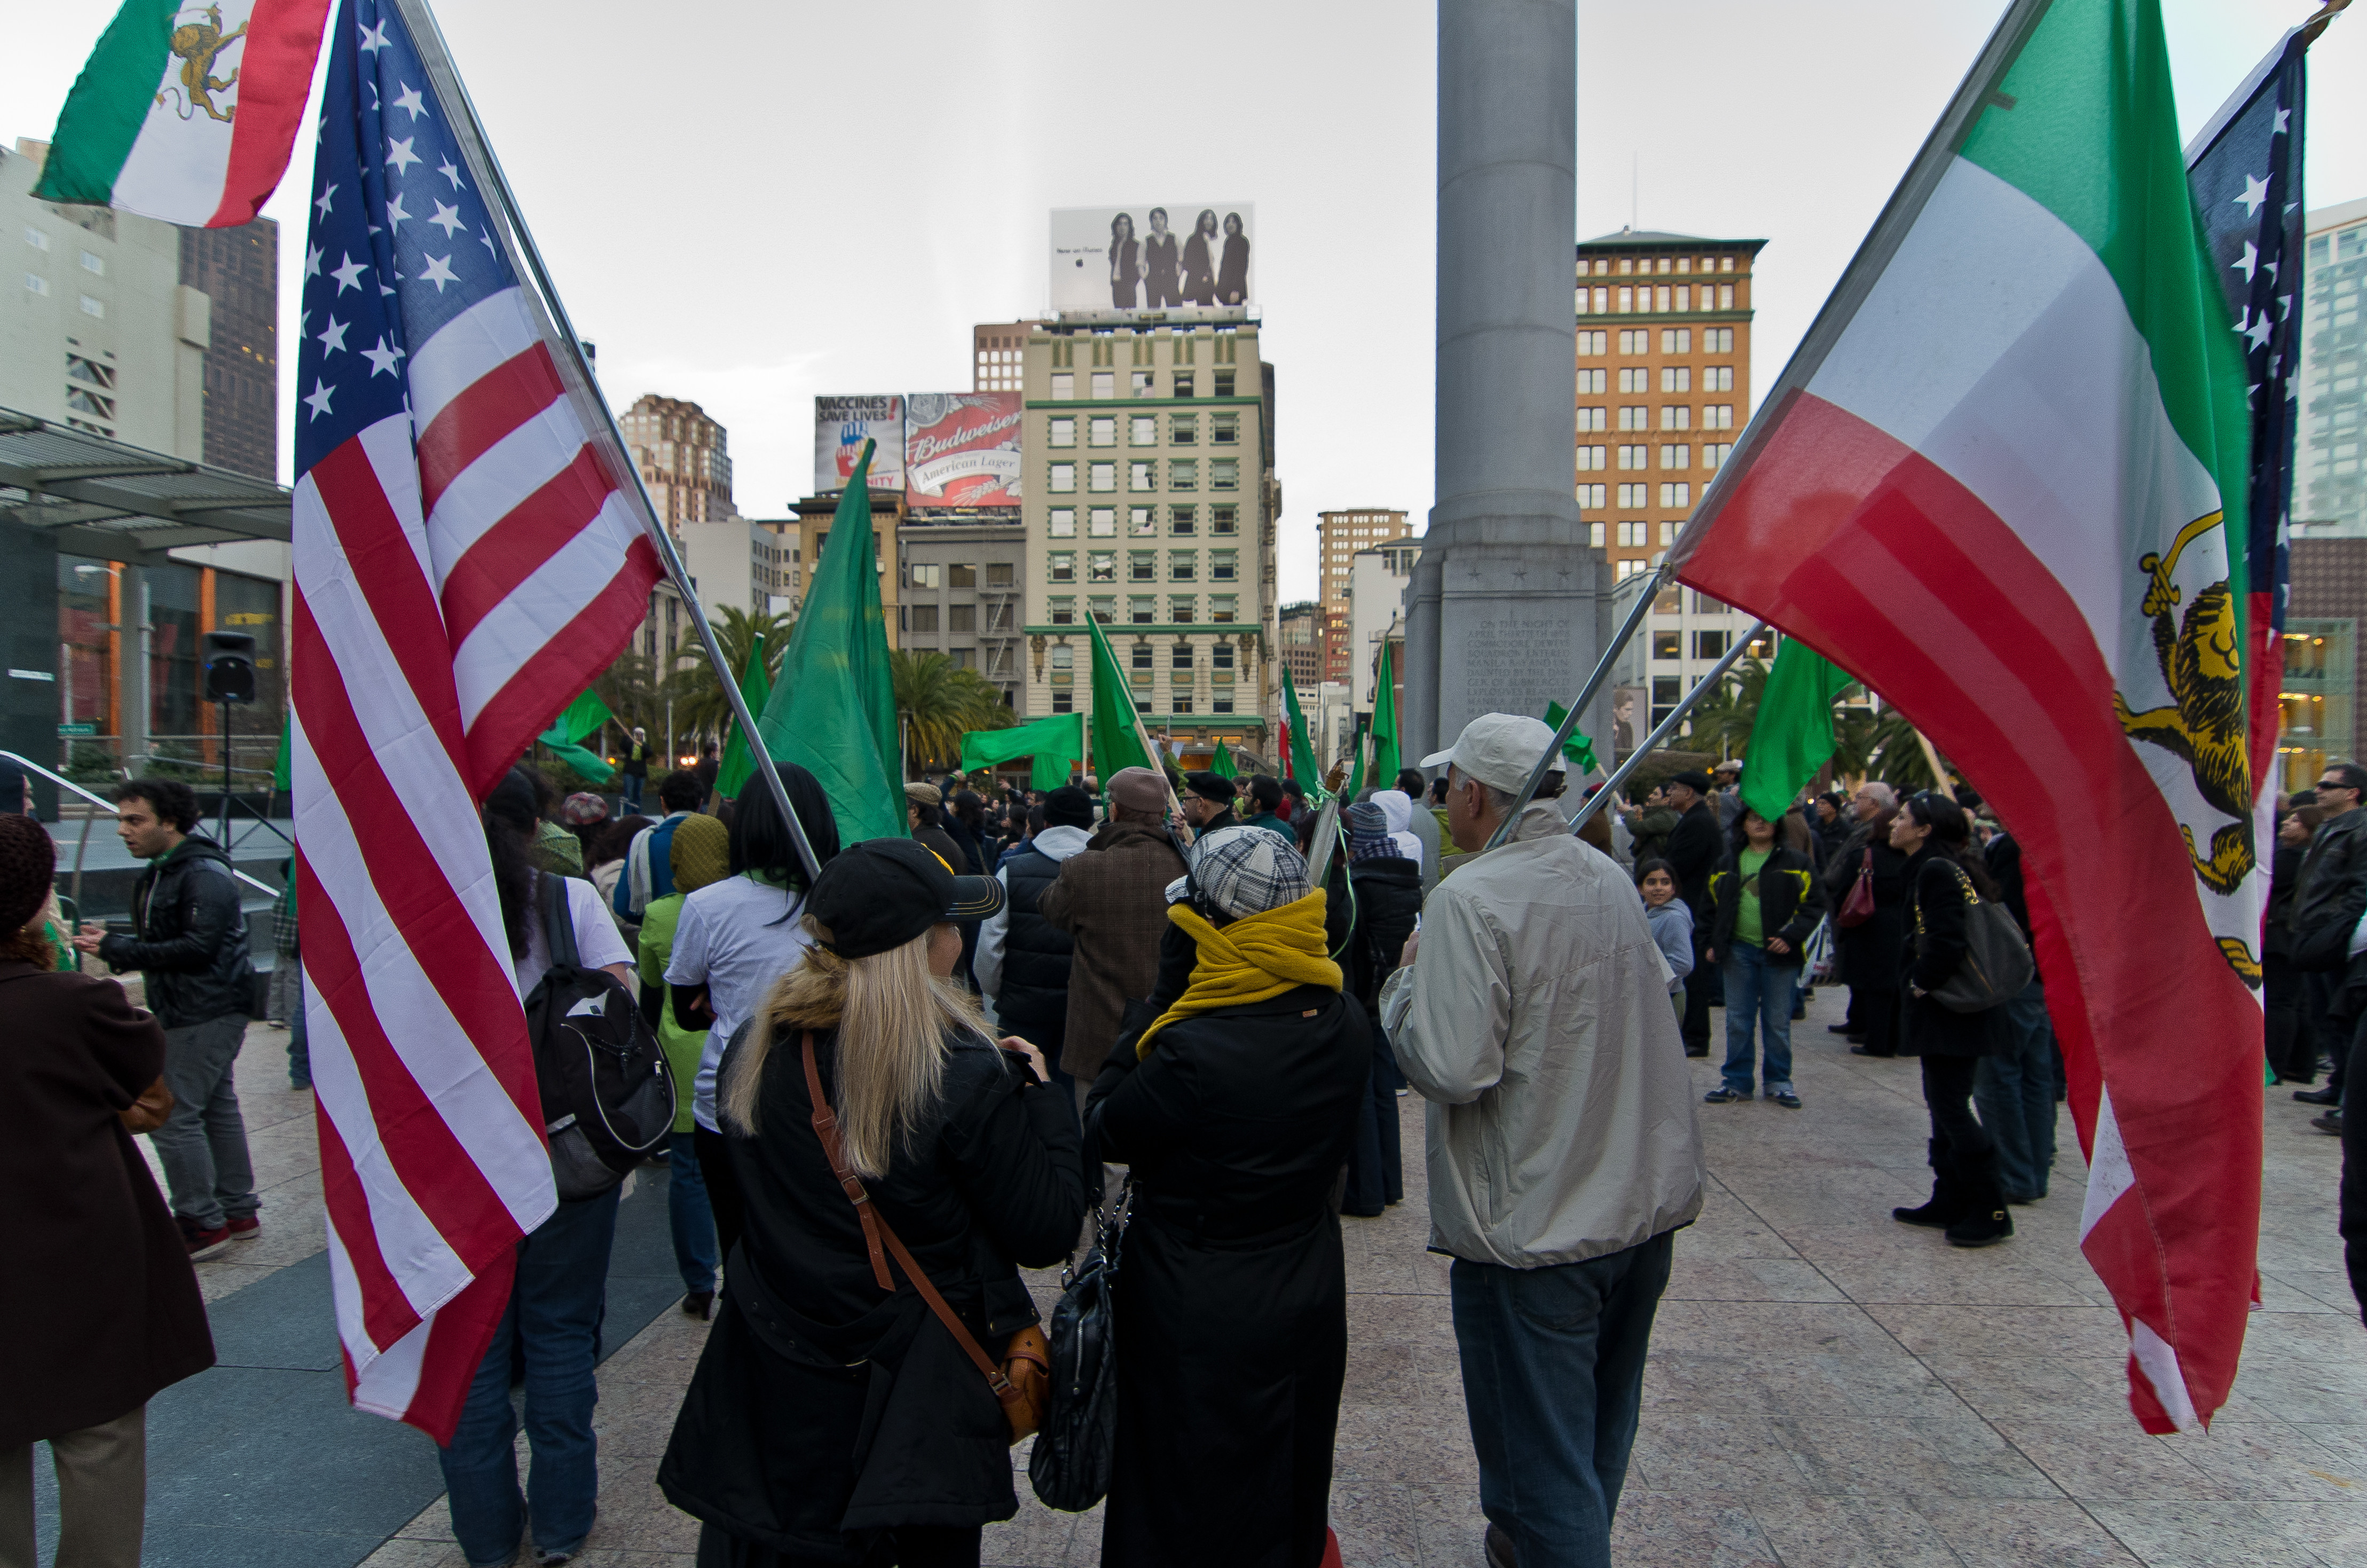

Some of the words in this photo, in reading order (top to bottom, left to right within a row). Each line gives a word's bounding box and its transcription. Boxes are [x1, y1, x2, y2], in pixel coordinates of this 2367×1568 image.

[819, 397, 887, 409] VACCINES
[819, 411, 849, 421] SAVE
[911, 411, 1022, 462] Budweiser
[922, 459, 977, 484] American
[981, 456, 1015, 468] Lager
